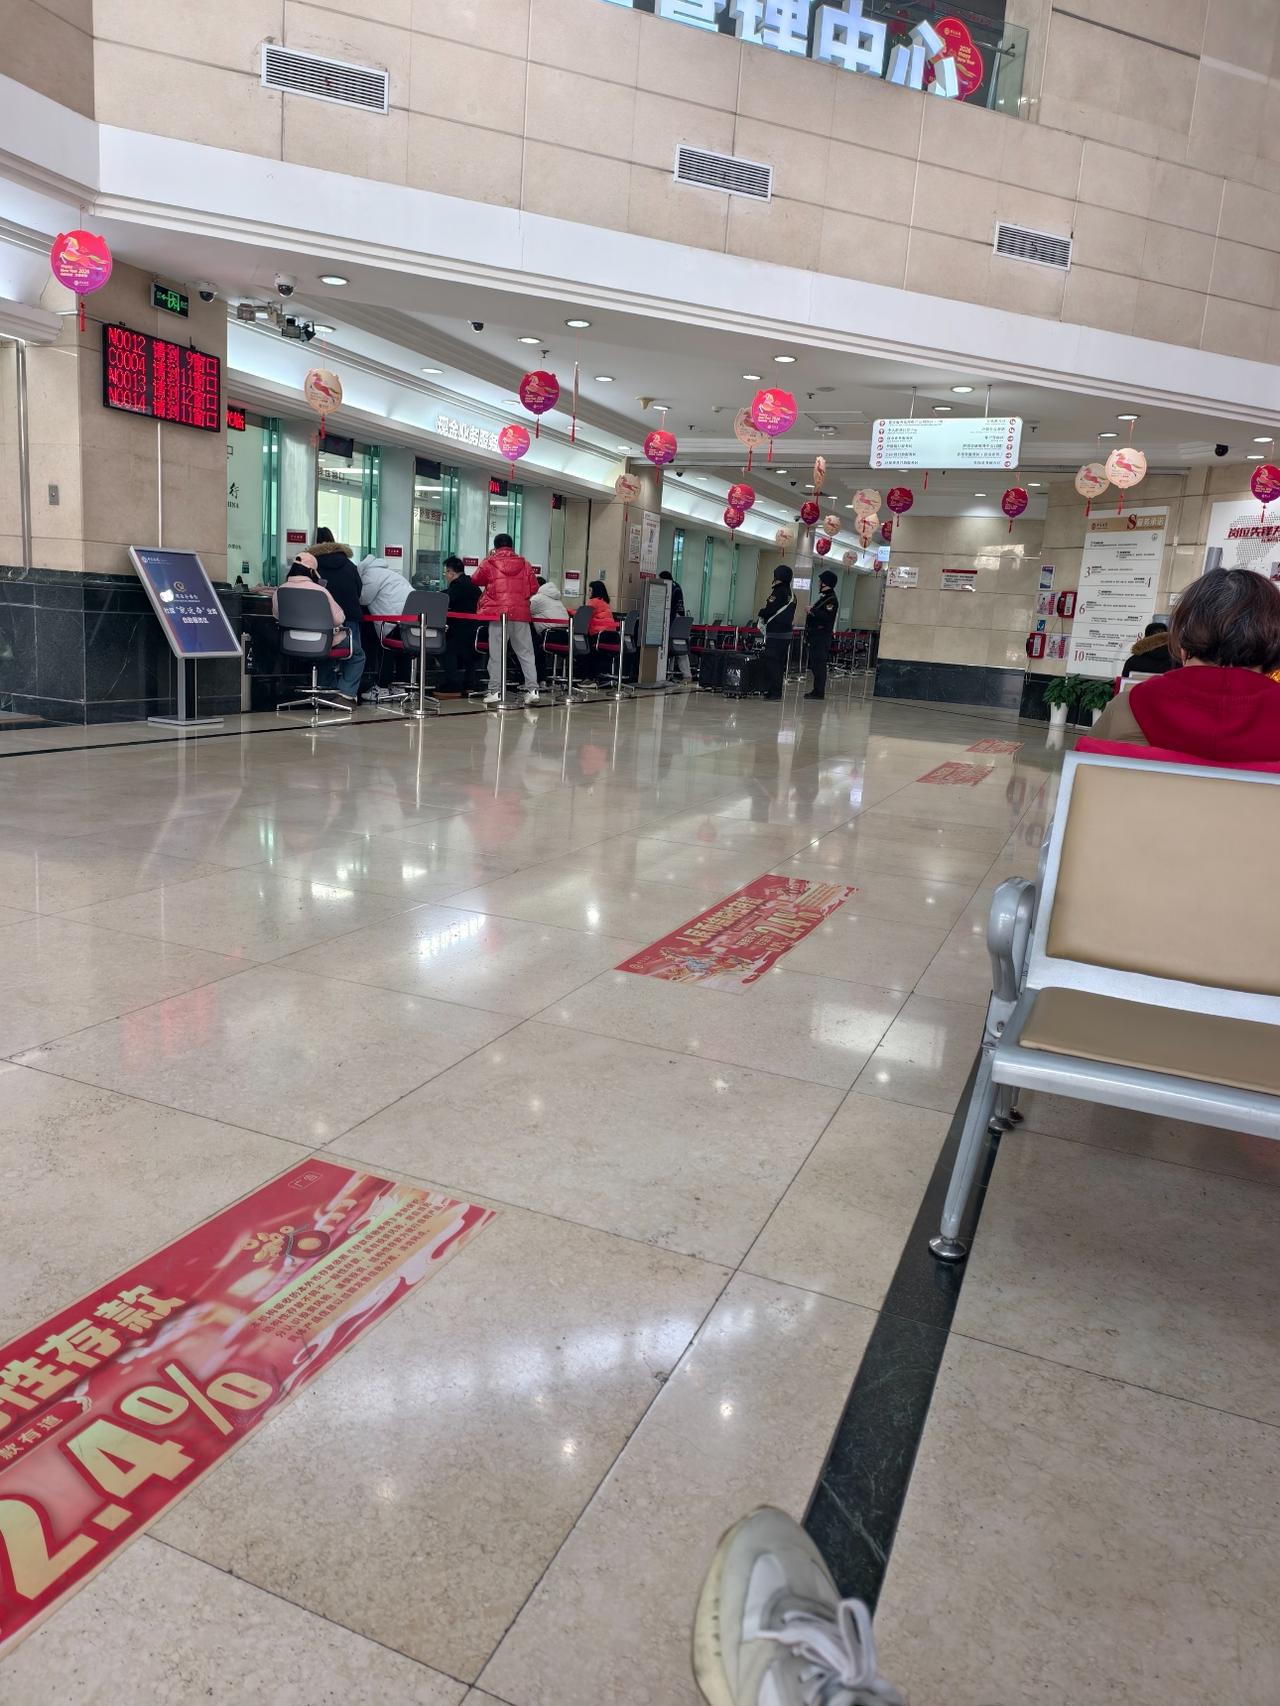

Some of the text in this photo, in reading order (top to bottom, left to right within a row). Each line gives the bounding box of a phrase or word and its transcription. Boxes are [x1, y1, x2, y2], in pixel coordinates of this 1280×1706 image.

[108, 327, 146, 354] N0012
[108, 347, 146, 374] C0004
[108, 367, 146, 393] N0013
[108, 386, 146, 412] N0014
[1074, 650, 1085, 662] 10
[0, 1285, 186, 1430] 性存款
[0, 1363, 273, 1600] 2.4%
